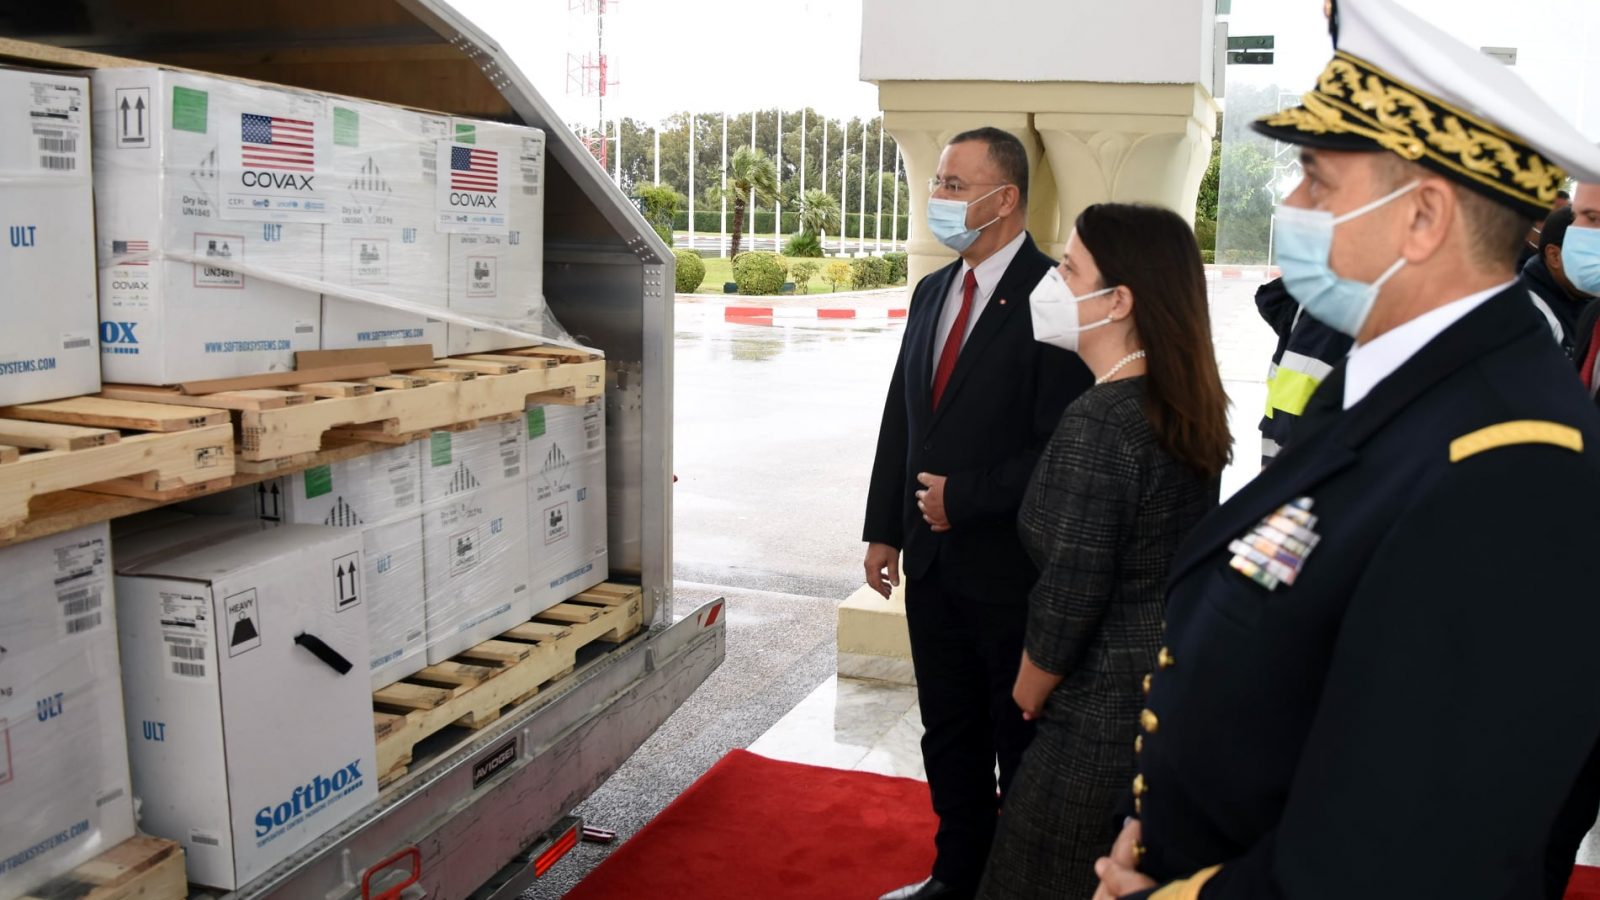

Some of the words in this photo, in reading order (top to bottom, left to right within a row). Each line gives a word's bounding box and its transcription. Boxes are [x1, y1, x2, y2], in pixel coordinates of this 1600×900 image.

[241, 170, 314, 191] COVAX
[183, 196, 195, 206] Dry
[450, 192, 497, 208] COVAX
[10, 226, 36, 247] ULT
[263, 223, 283, 242] ULT
[402, 227, 418, 243] ULT
[508, 230, 520, 245] ULT
[112, 281, 149, 290] COVAX
[205, 340, 291, 353] WWW.SOFTBOXSYSTEMS.COM
[490, 518, 503, 535] ULT
[377, 555, 391, 574] ULT
[229, 599, 254, 615] HEAVY
[36, 692, 64, 723] ULT
[143, 720, 166, 742] ULT
[474, 747, 514, 781] AVIOGEI
[255, 758, 363, 838] Softbox
